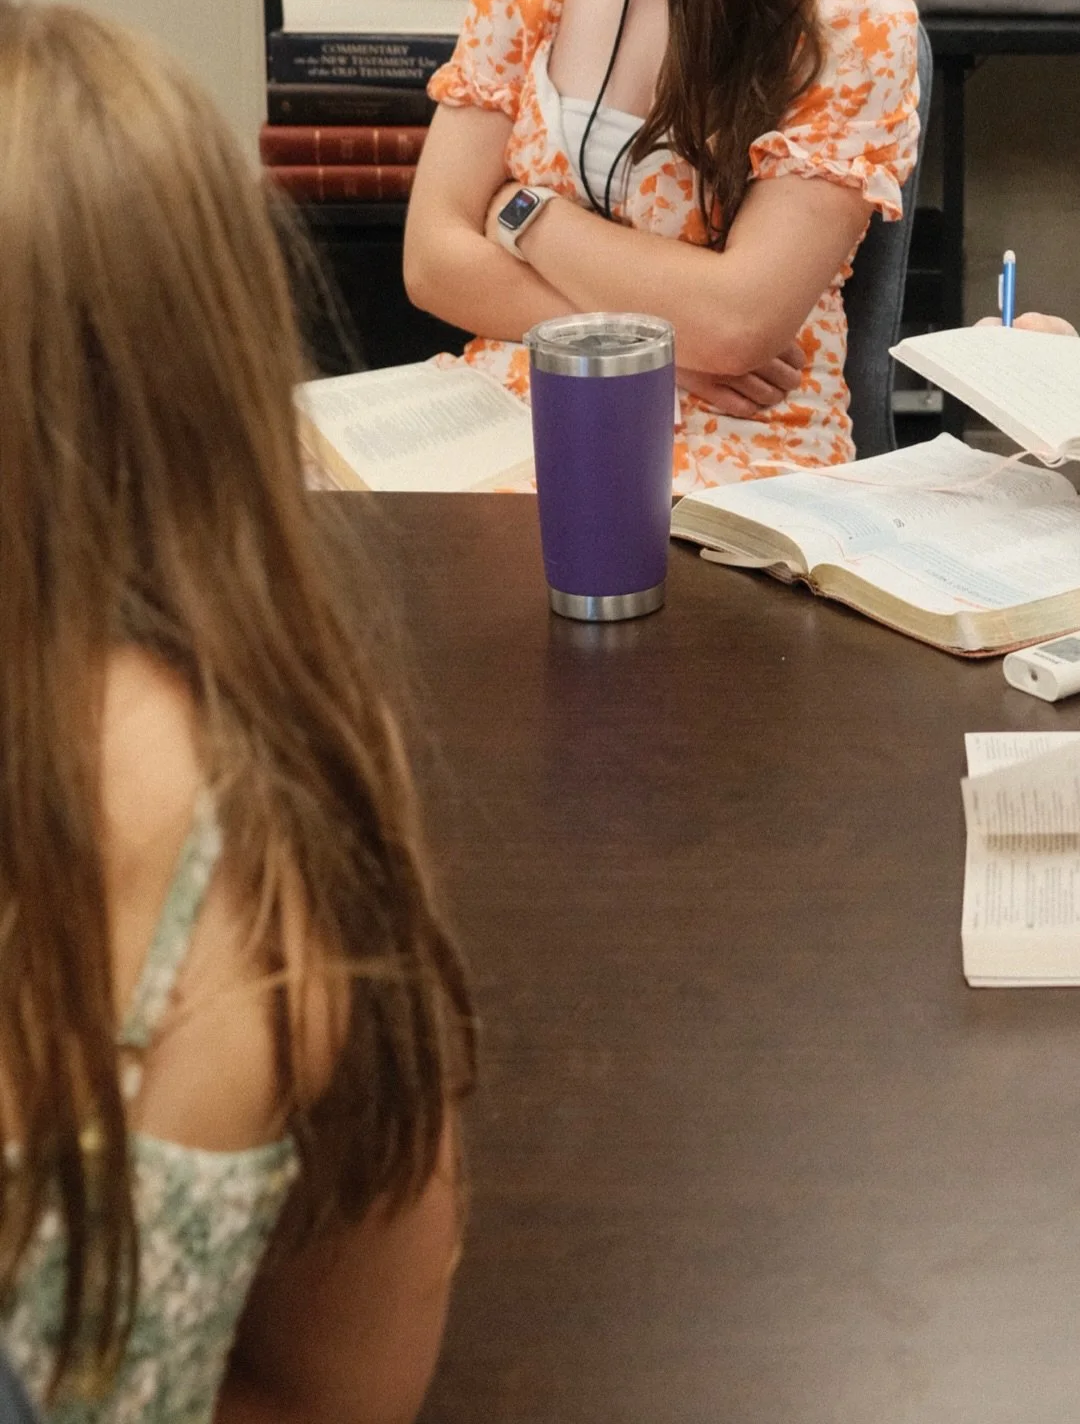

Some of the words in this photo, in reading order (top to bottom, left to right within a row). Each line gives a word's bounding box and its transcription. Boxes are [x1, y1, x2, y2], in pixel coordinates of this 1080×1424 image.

[322, 43, 410, 55] COMMENTARY
[321, 55, 348, 65] NEW
[352, 56, 415, 67] TESTAMENT
[331, 67, 358, 77] OLD
[361, 67, 423, 78] TESTAMENT
